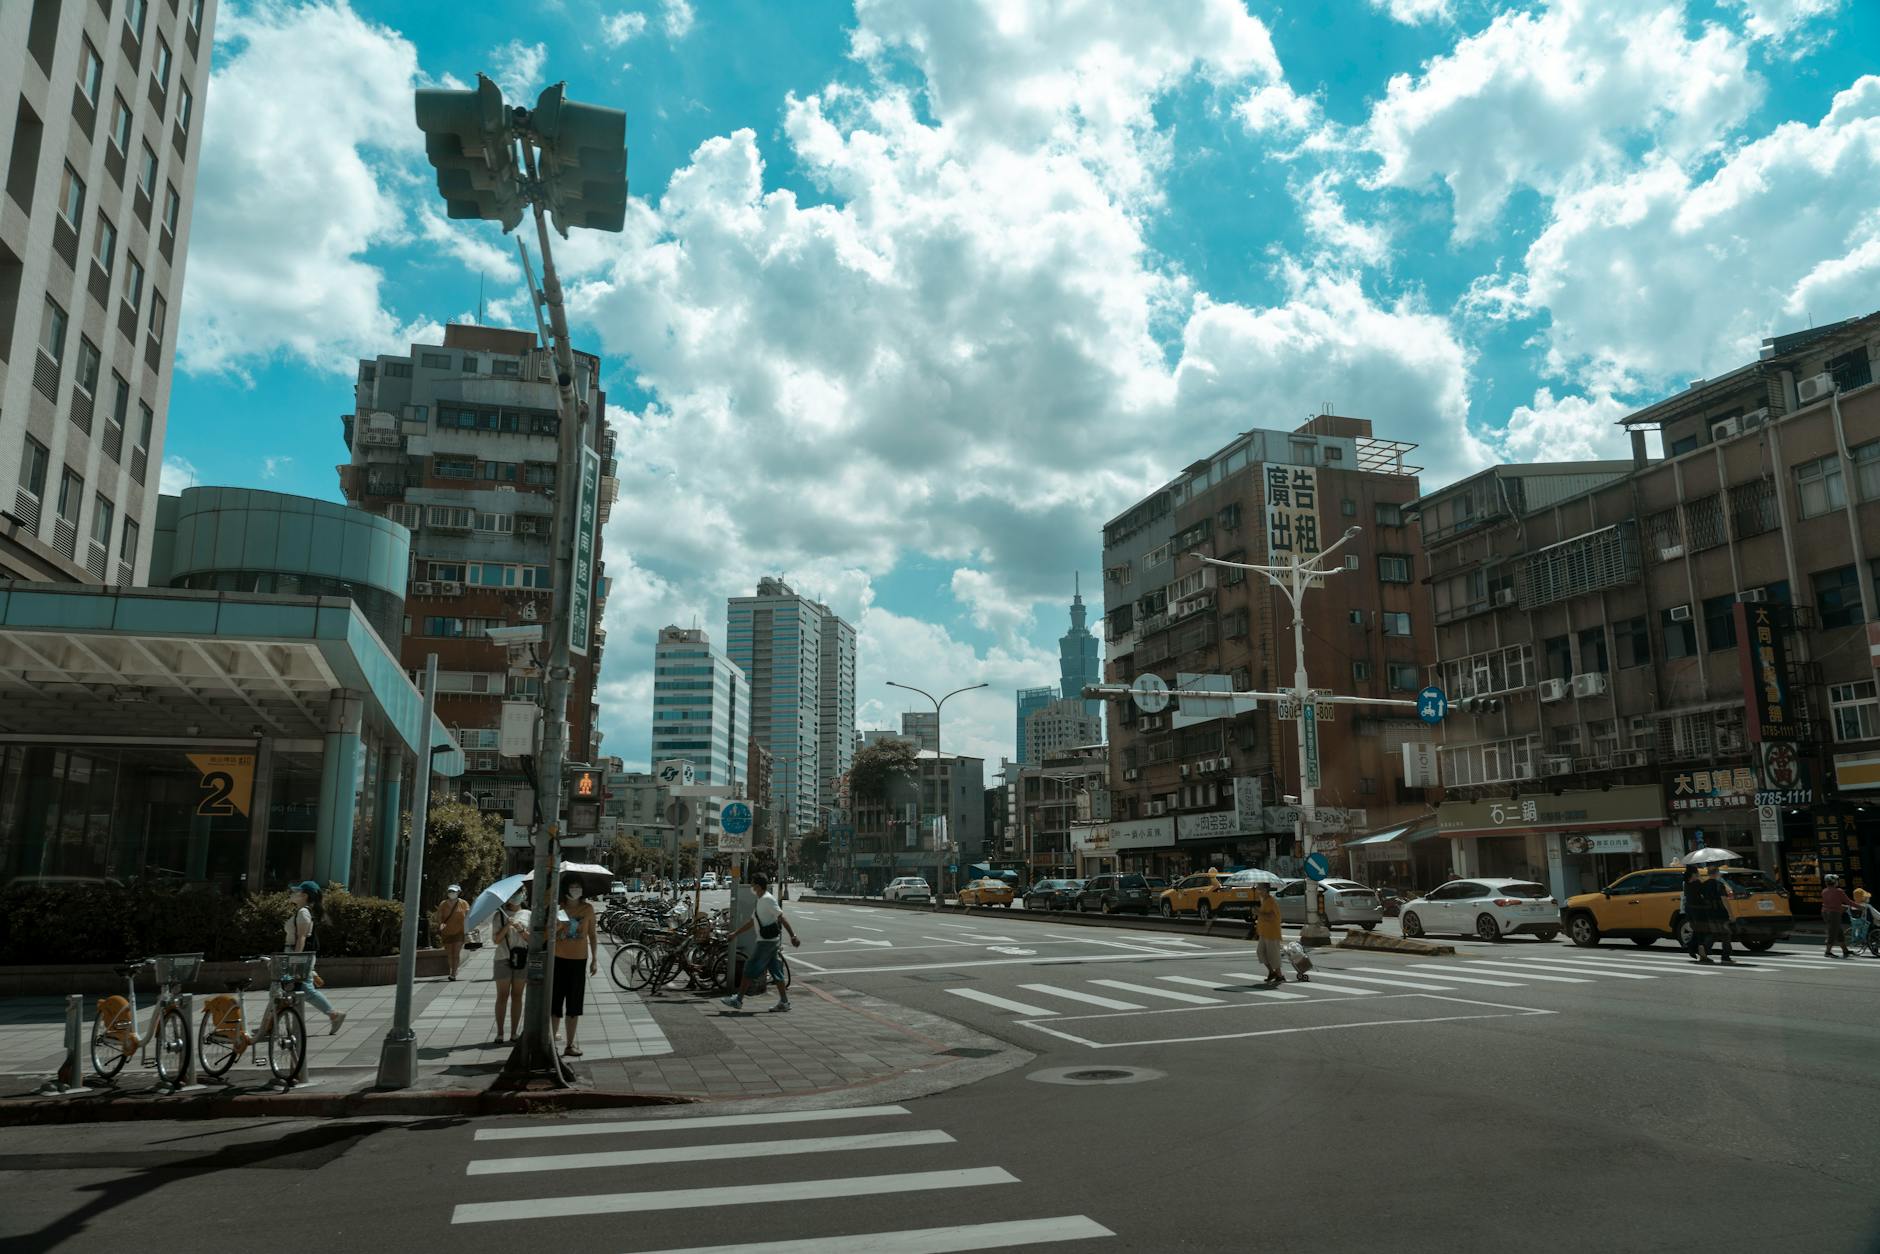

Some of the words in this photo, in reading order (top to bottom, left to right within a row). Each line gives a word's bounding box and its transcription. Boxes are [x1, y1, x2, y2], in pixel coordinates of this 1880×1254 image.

[1266, 466, 1315, 509] 廣告
[1270, 511, 1319, 554] 出租
[196, 770, 234, 816] 2
[1673, 767, 1754, 795] 大同精品
[1754, 789, 1813, 806] 8785-1111
[1488, 800, 1538, 825] 石二鍋
